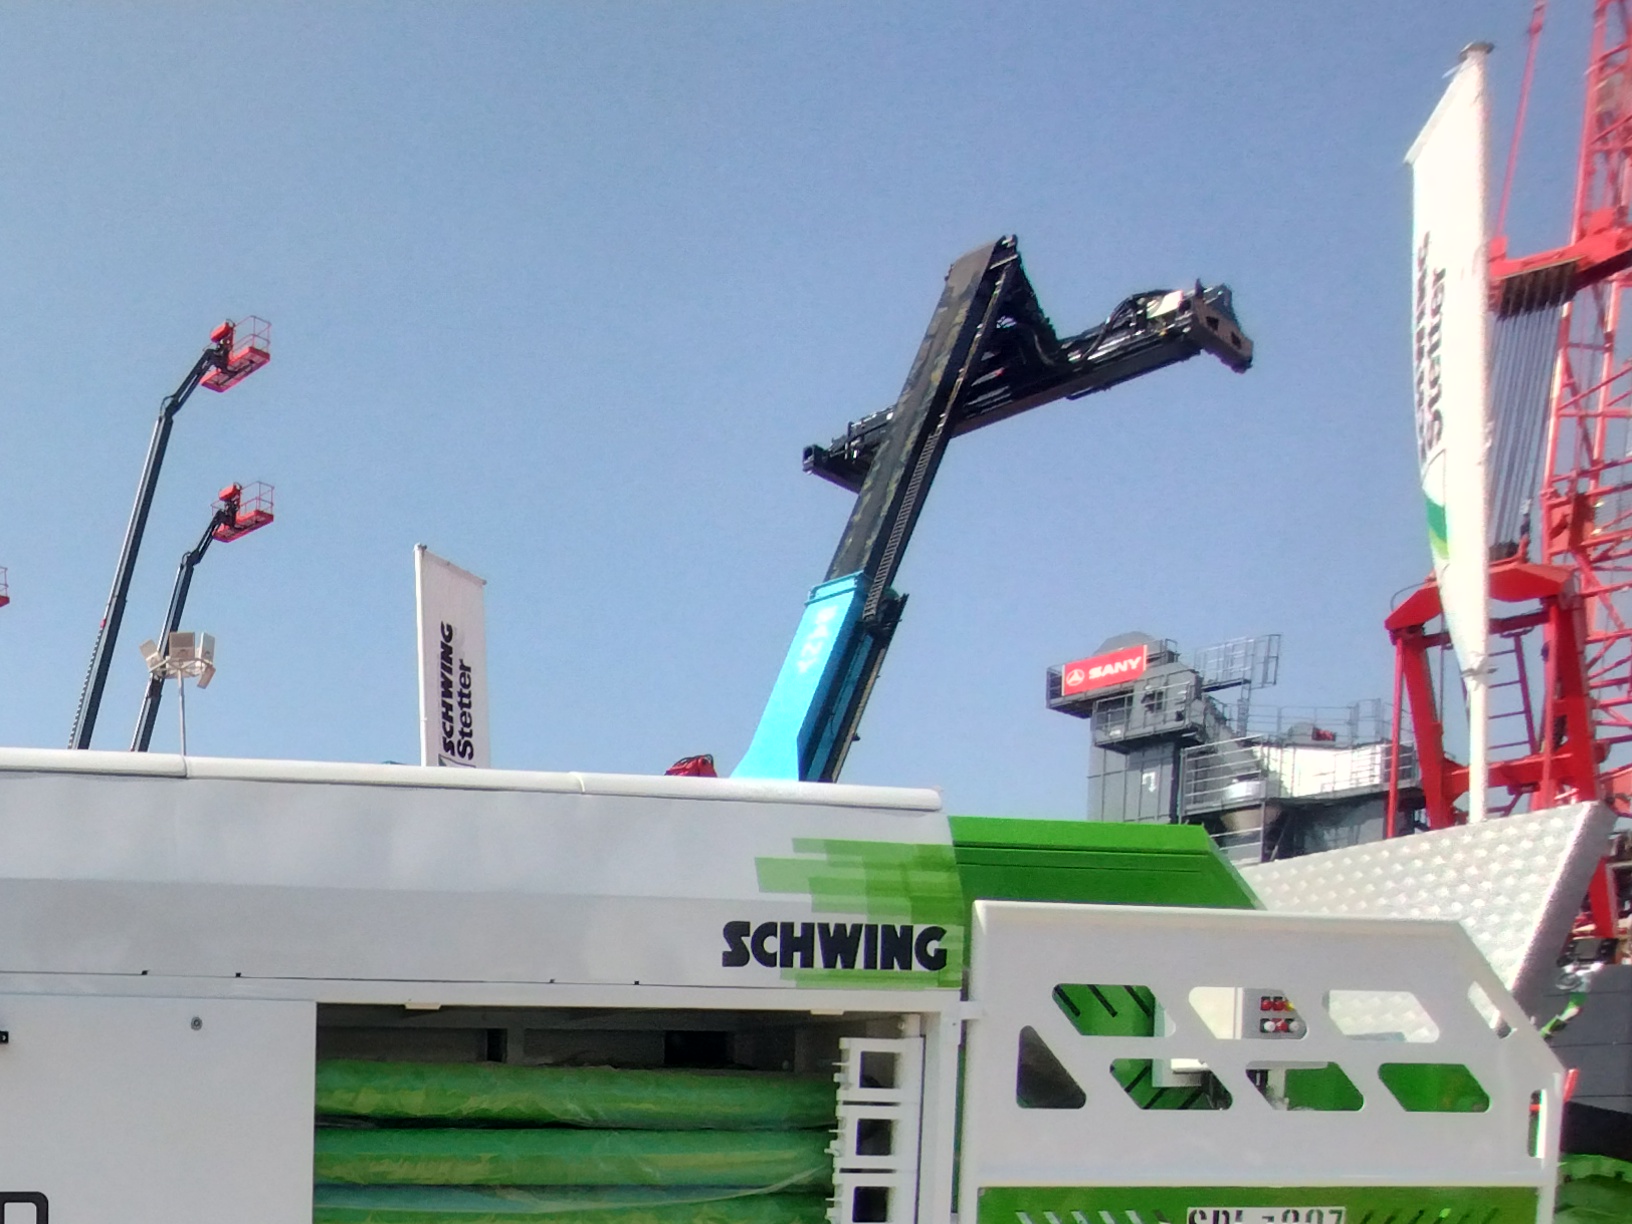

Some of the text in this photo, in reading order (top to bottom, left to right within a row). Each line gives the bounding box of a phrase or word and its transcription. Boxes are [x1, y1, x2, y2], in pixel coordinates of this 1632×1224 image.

[440, 620, 455, 756] SCHWING
[1088, 656, 1142, 680] SANY
[457, 658, 474, 760] Stetter
[721, 921, 948, 971] SCHWING
